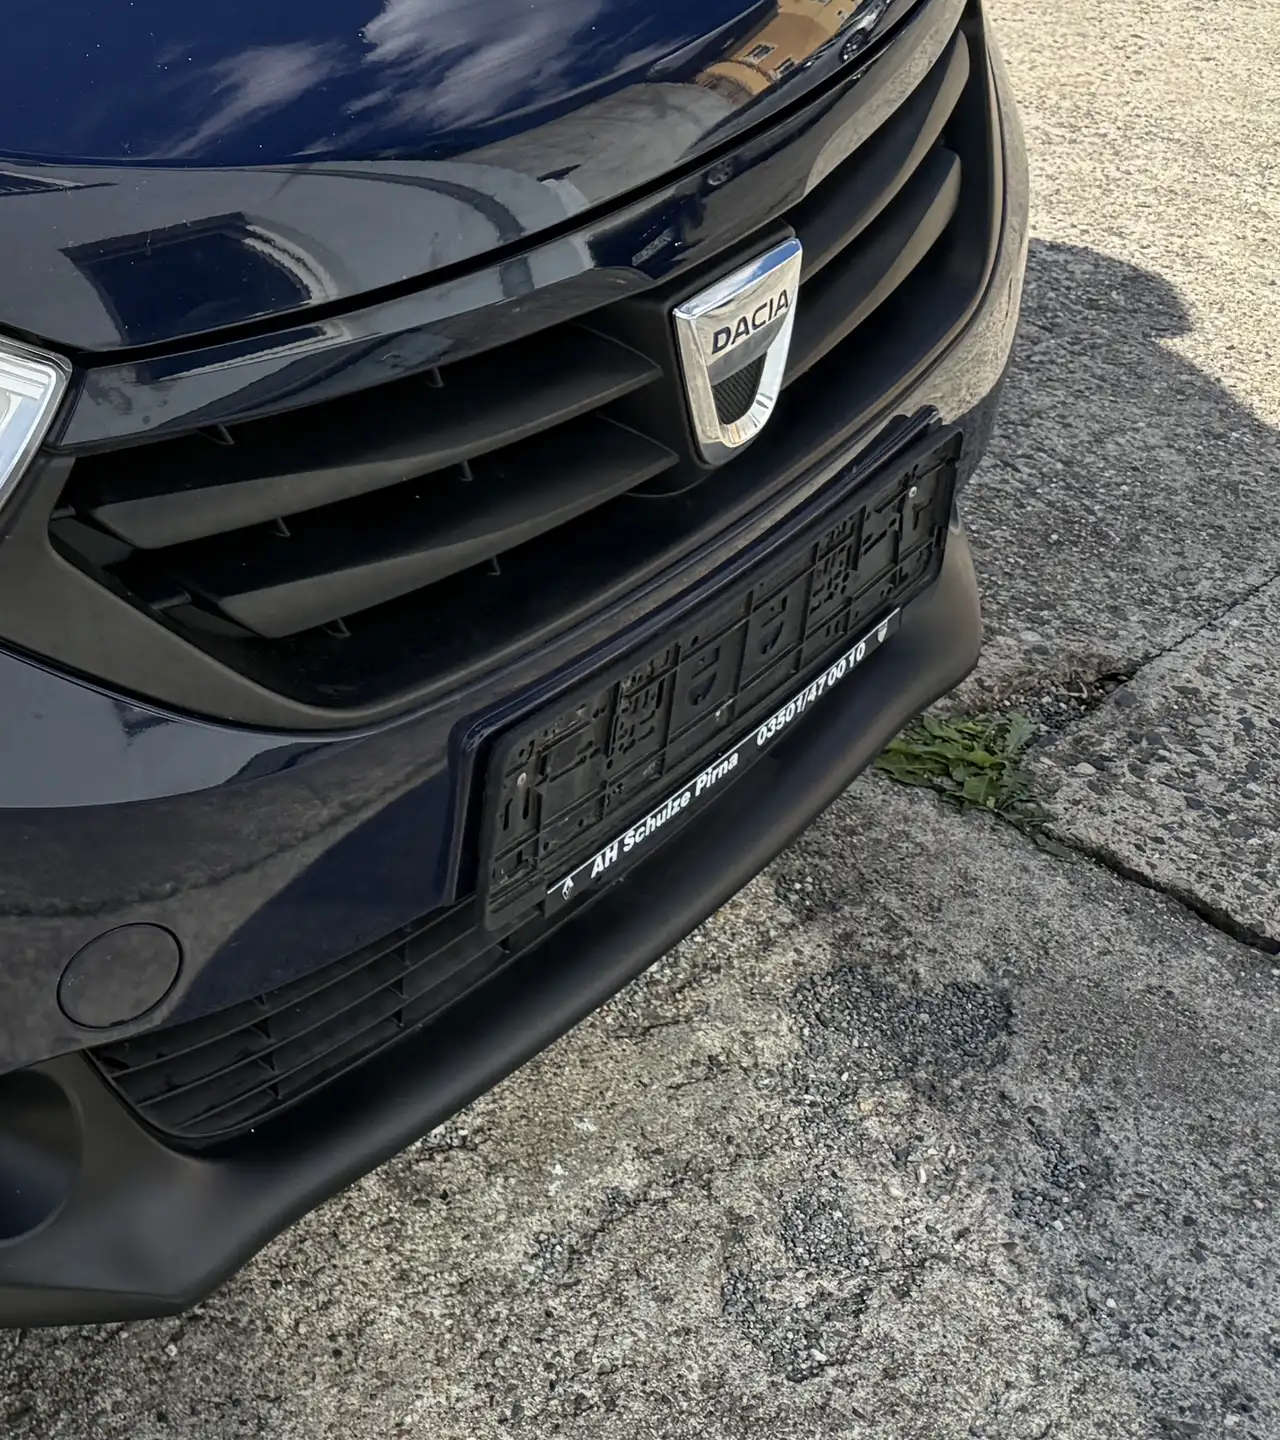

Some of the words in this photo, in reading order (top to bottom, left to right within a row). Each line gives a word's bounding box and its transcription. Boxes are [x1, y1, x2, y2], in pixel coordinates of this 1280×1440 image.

[711, 289, 789, 355] DACIA
[591, 841, 618, 879] AH
[623, 791, 691, 852] Schulze
[695, 752, 739, 797] Pirna
